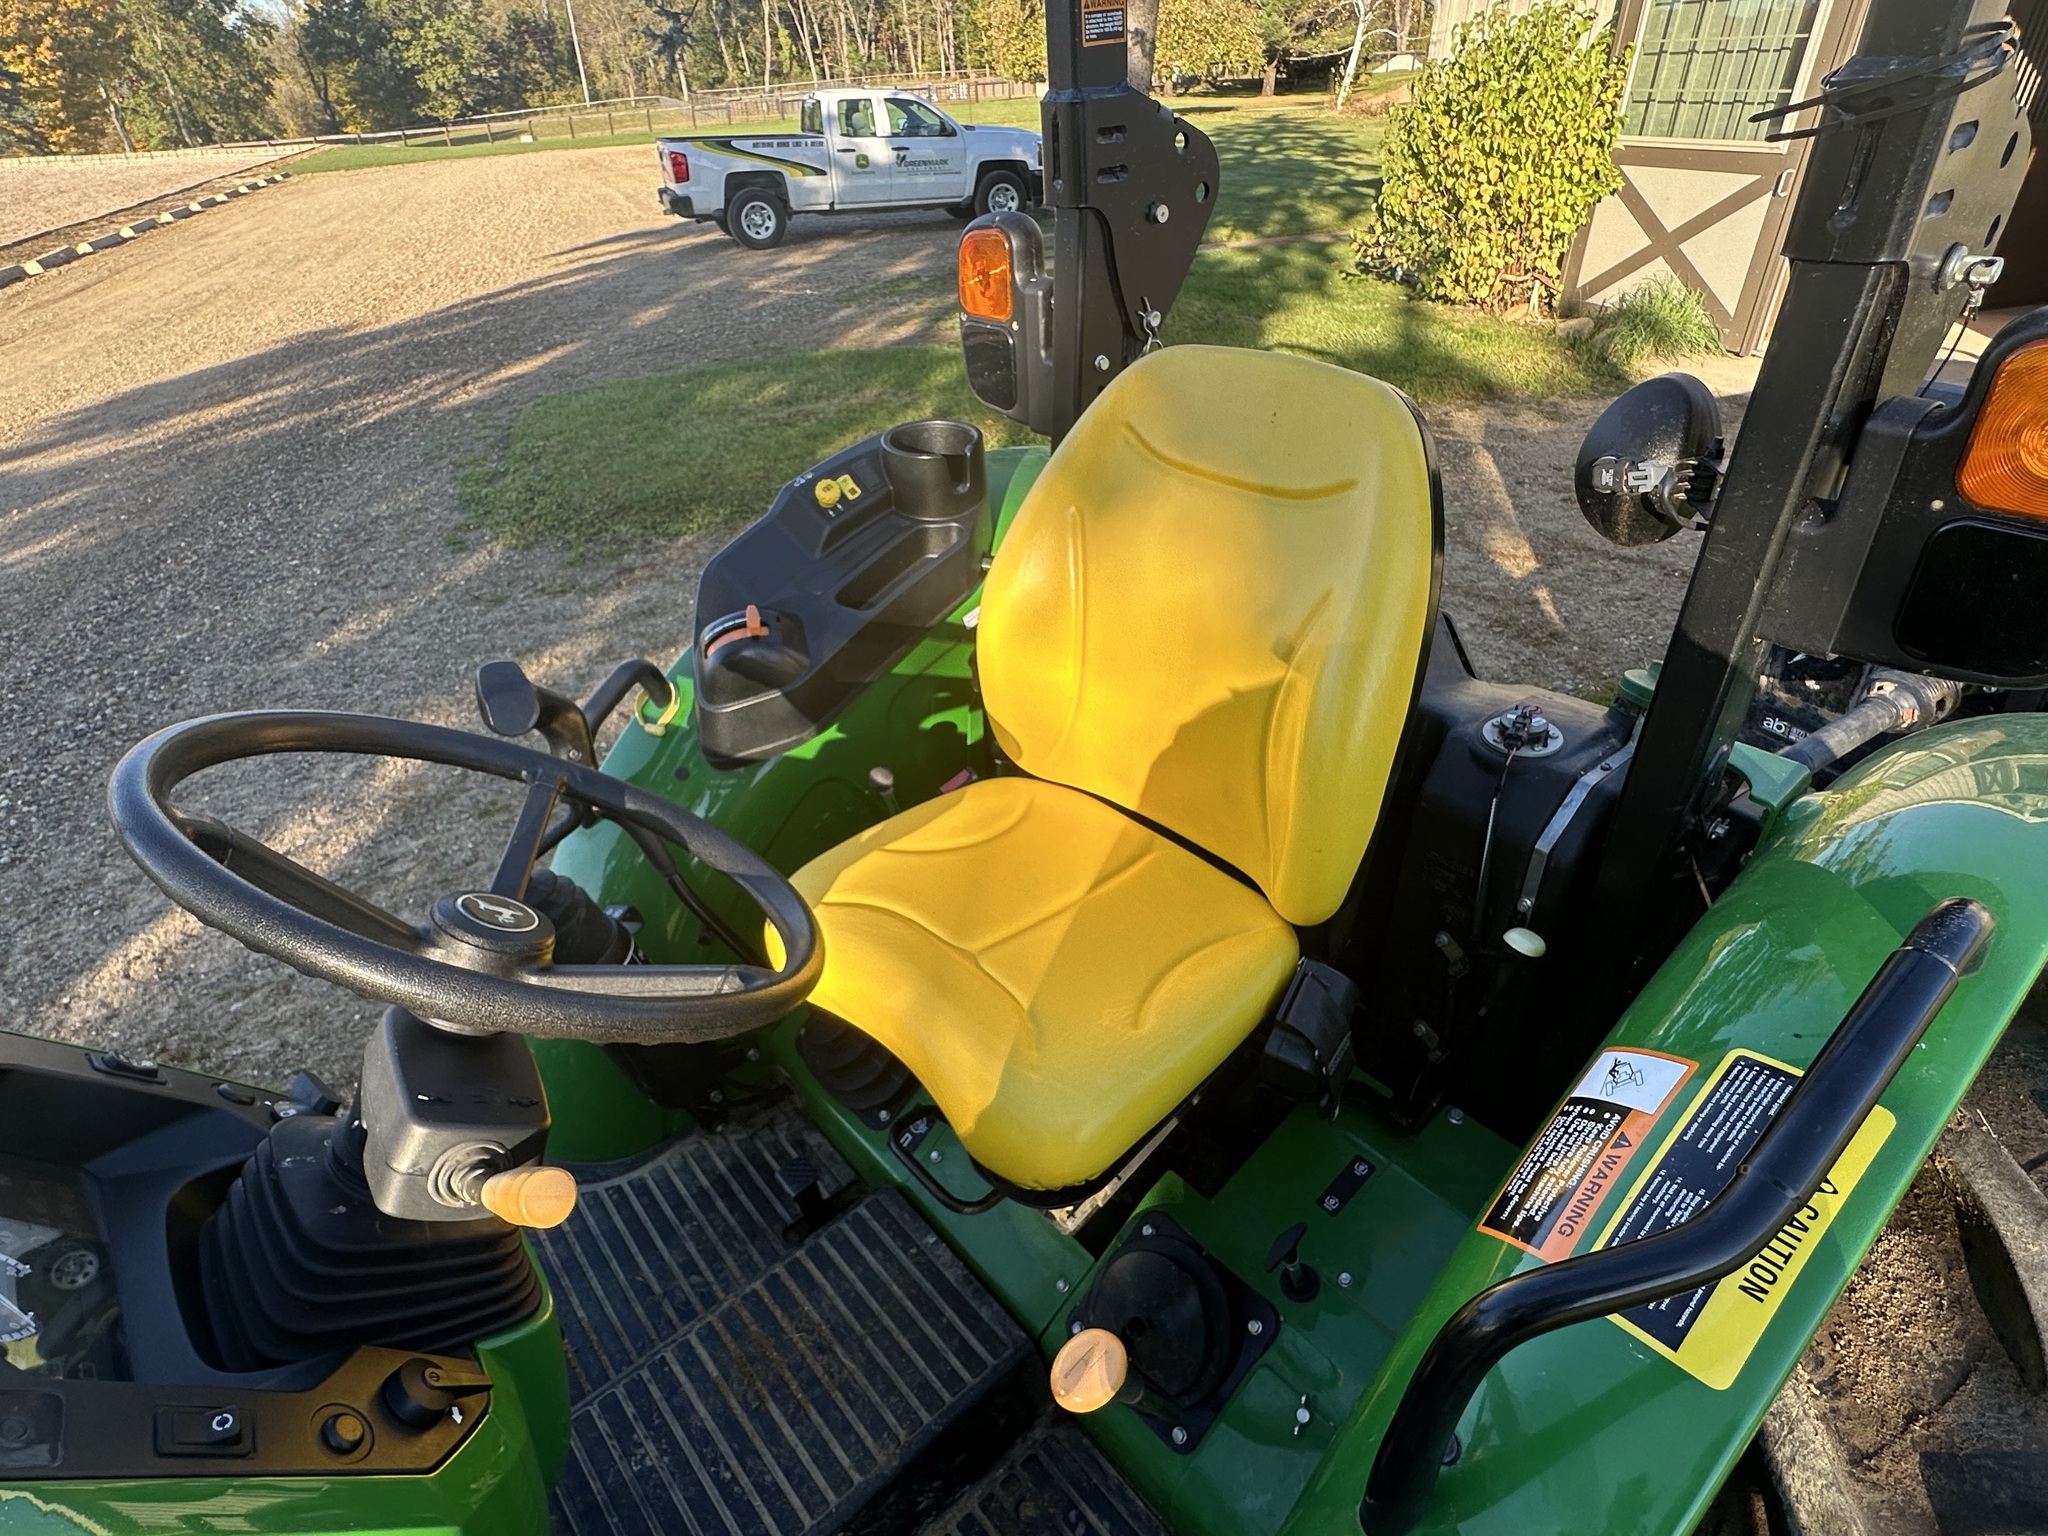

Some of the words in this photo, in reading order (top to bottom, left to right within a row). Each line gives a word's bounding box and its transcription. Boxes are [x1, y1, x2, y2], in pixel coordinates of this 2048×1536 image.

[1556, 1116, 1567, 1128] DO
[1564, 1105, 1582, 1126] When
[1568, 1118, 1582, 1133] Use
[1577, 1119, 1588, 1131] Do
[1585, 1123, 1604, 1144] Keep
[1599, 1113, 1621, 1140] AVOID
[1539, 1127, 1565, 1162] structure
[1544, 1129, 1557, 1146] NOT
[1555, 1134, 1569, 1151] seat
[1566, 1132, 1579, 1145] not
[1567, 1121, 1596, 1158] Structure
[1533, 1147, 1544, 1161] use
[1542, 1152, 1558, 1168] belt.
[1549, 1145, 1570, 1166] jump
[1562, 1145, 1588, 1179] Rollover
[1566, 1140, 1602, 1188] CRUSHING:
[1521, 1162, 1534, 1179] seat
[1525, 1162, 1541, 1182] must
[1552, 1158, 1570, 1176] fully
[1518, 1183, 1528, 1194] be
[1524, 1174, 1550, 1209] machine
[1527, 1176, 1556, 1216] extended.
[1558, 1154, 1622, 1237] WARNING
[1500, 1195, 1519, 1220] down:
[1534, 1178, 1565, 1221] Protective
[1512, 1210, 1527, 1228] tips.
[1738, 1206, 1819, 1304] CAUTION
